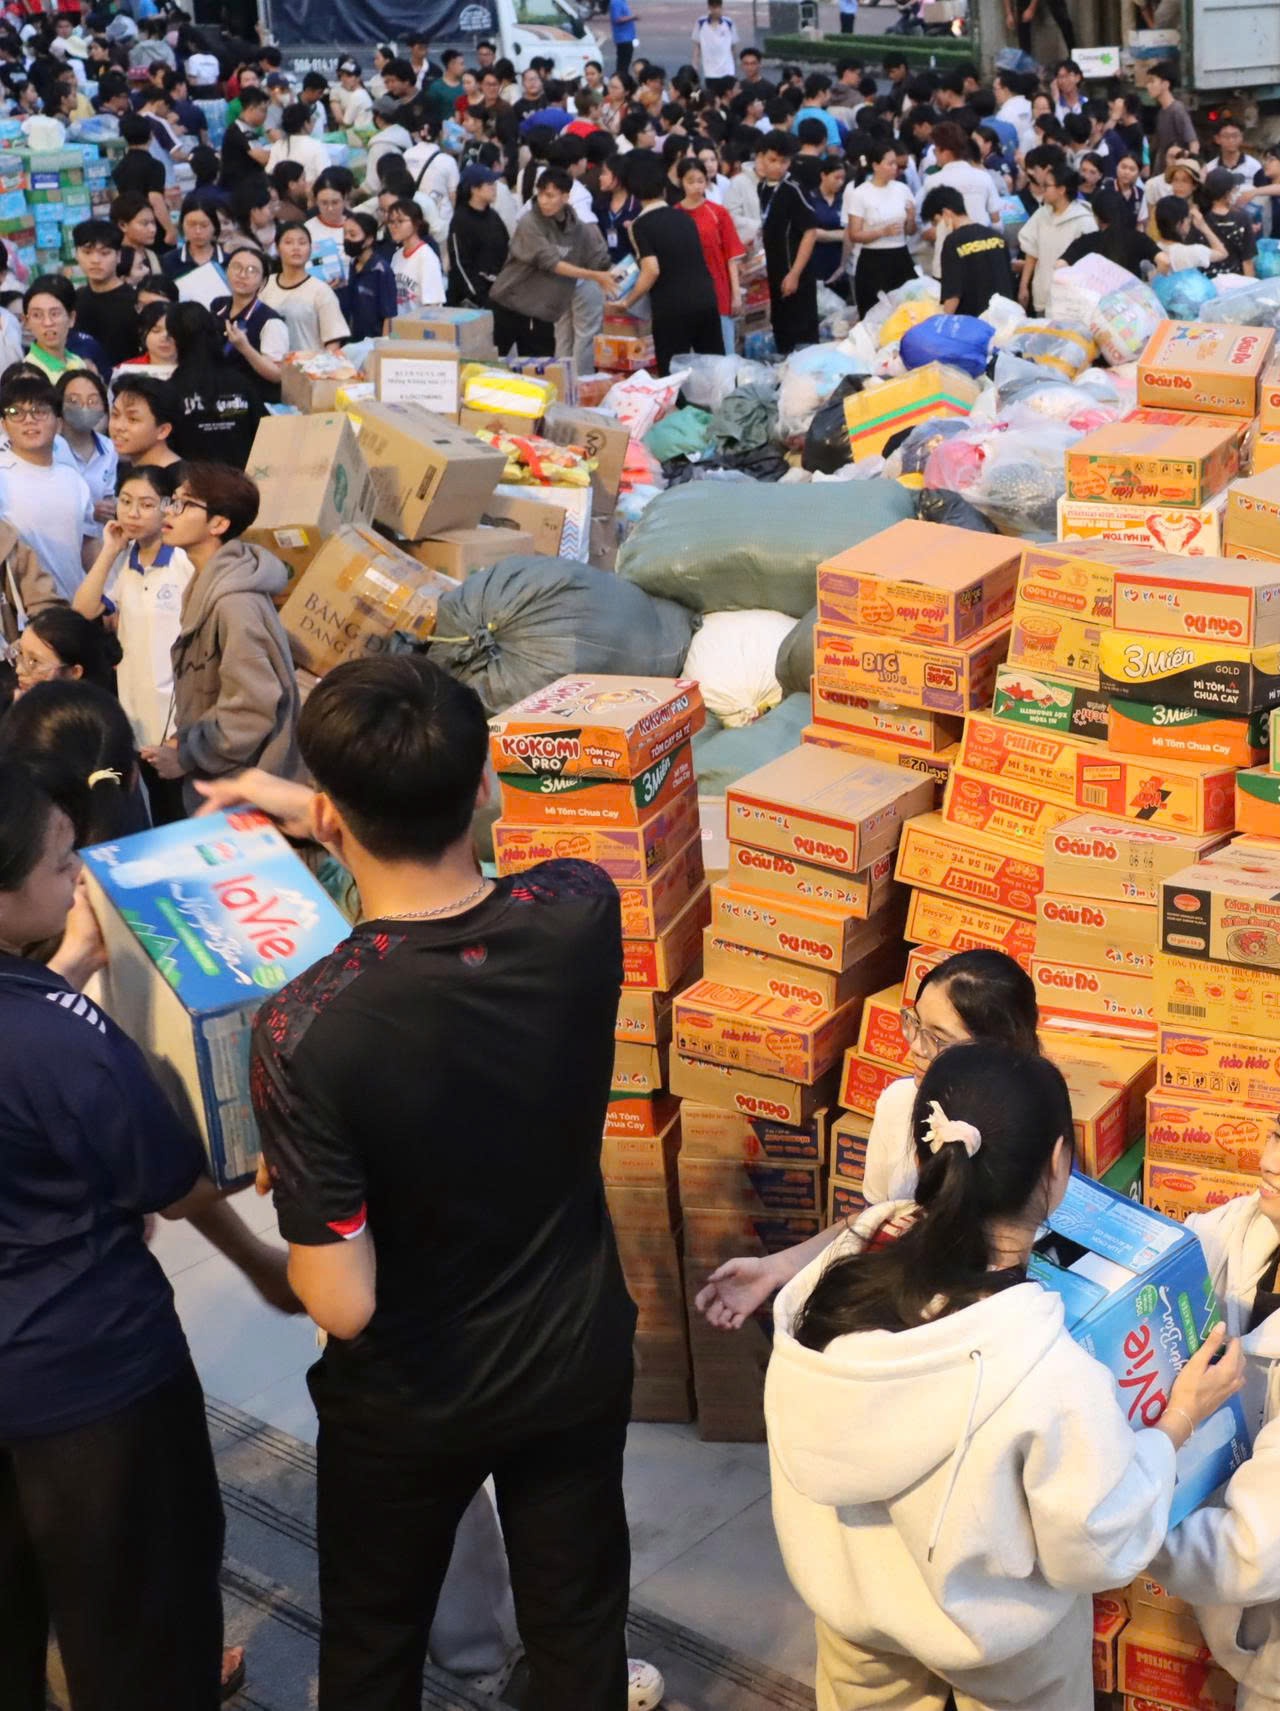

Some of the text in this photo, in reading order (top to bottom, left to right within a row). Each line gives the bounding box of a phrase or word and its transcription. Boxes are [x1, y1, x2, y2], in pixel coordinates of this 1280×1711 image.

[862, 652, 898, 673] BIG
[1216, 665, 1240, 676] GOLD
[1193, 680, 1226, 692] MÌ TÔM
[1193, 690, 1239, 704] CHUA CAY
[639, 706, 671, 734] KOKOMI
[501, 736, 581, 758] KOKOMI
[584, 747, 621, 760] TÔM CAY
[1003, 732, 1058, 757] MILIKET
[1152, 737, 1231, 756] Mì Tôm Chua Cay
[532, 757, 562, 770] PRO
[592, 758, 614, 768] SA TẾ
[988, 790, 1040, 816] MILIKET
[1054, 835, 1118, 861] Gấu Đỏ
[738, 849, 797, 876] Gấu Đỏ
[948, 874, 1000, 900] MILIKET
[1121, 883, 1146, 898] Tôm
[1042, 902, 1106, 928] Gấu Đỏ
[1105, 948, 1144, 966] Gà Sợi
[1038, 968, 1100, 993] Gấu Đỏ
[768, 979, 823, 1007] Gấu Đỏ
[1103, 1000, 1144, 1016] Tôm và
[606, 1120, 646, 1132] hua Cay
